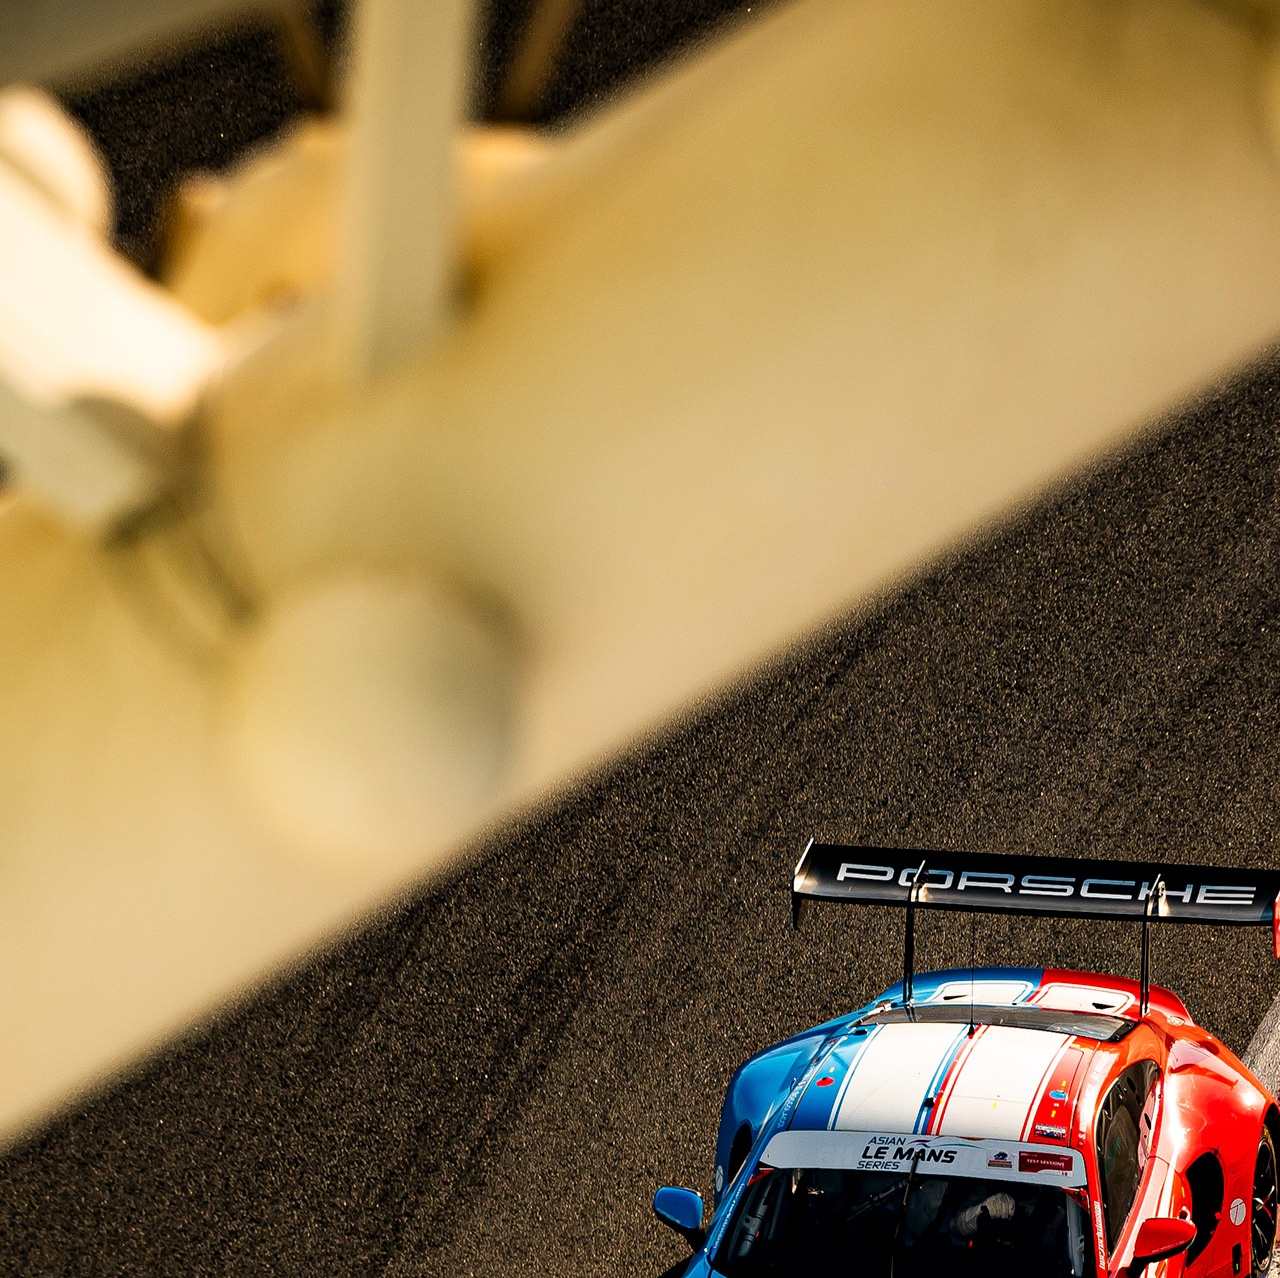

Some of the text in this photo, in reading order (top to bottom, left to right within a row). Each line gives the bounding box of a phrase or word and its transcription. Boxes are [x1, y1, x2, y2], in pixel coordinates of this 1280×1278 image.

[836, 863, 1257, 905] PORSCHE
[868, 1136, 907, 1146] ASIAN
[861, 1146, 958, 1164] LE MANS
[856, 1160, 900, 1170] SERIES
